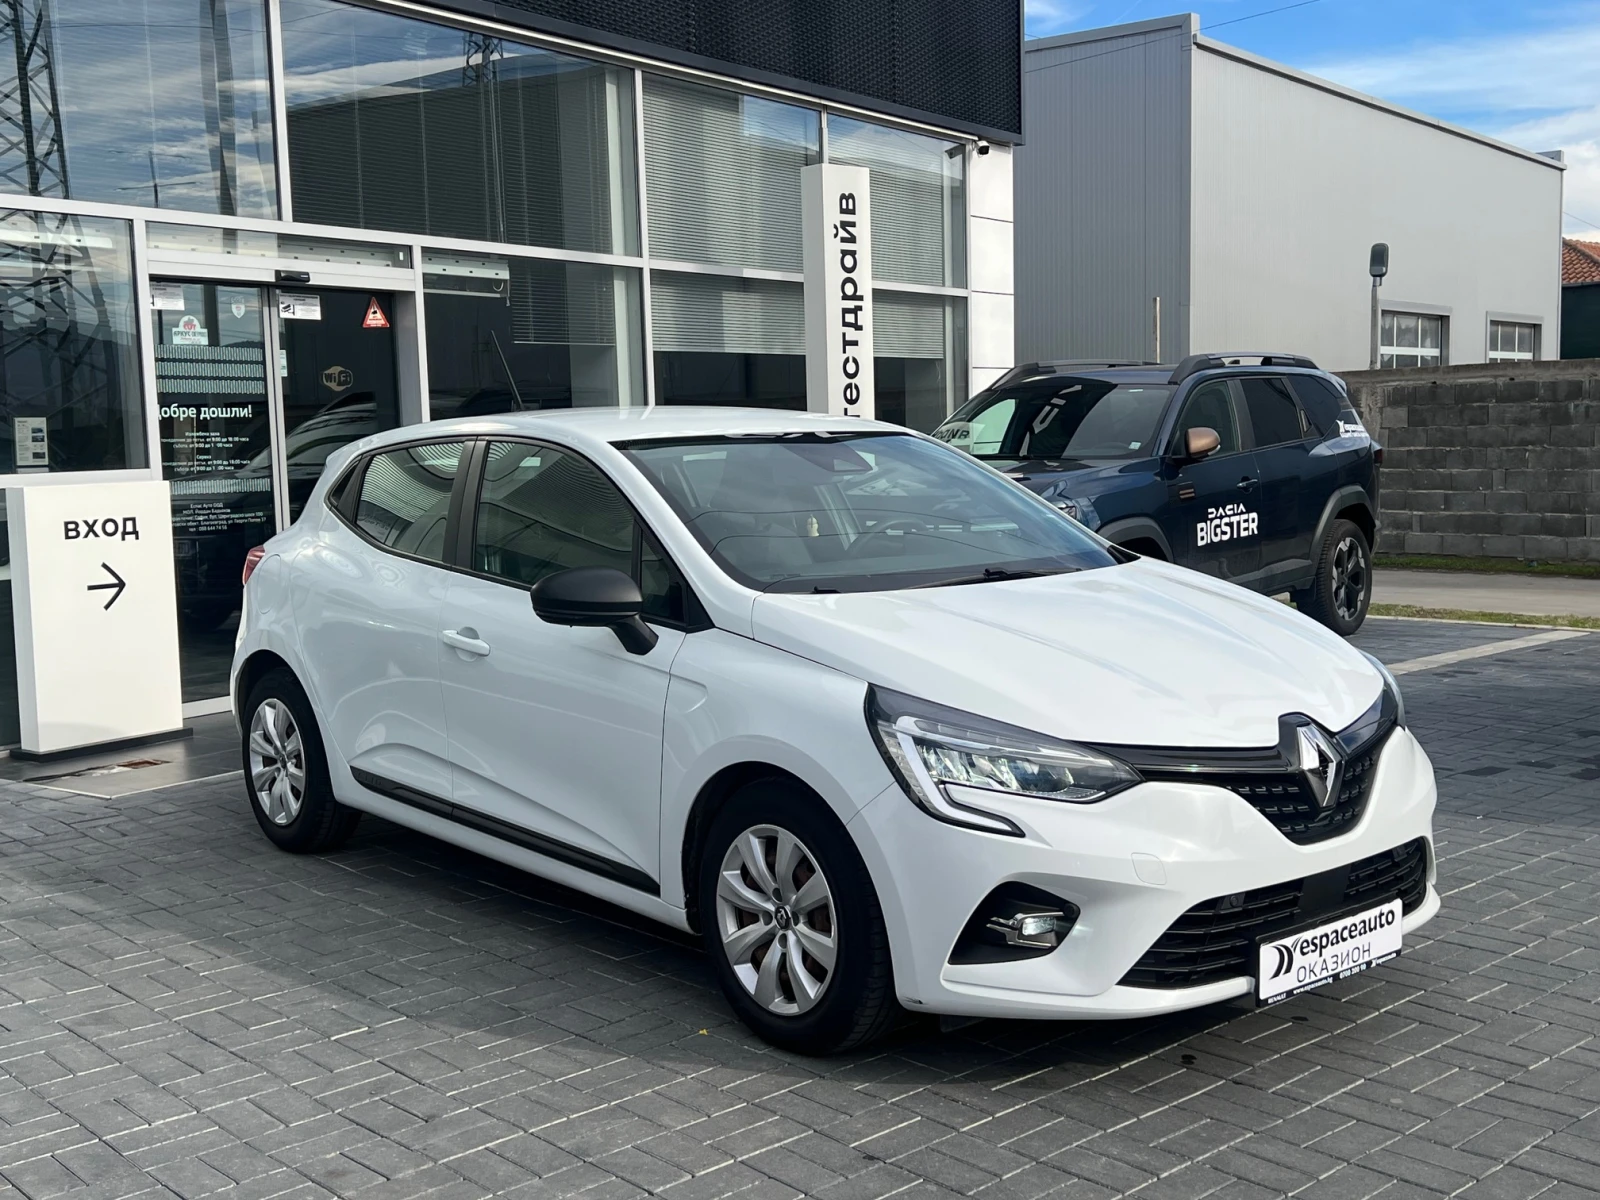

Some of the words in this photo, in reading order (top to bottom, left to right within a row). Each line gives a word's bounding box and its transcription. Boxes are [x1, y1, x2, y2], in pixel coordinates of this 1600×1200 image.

[159, 404, 196, 421] обре
[200, 404, 252, 420] дошли!
[1208, 502, 1246, 518] DACIA
[1196, 512, 1258, 546] BIGSTER
[1300, 909, 1396, 958] espaceauto
[1296, 942, 1372, 983] ОКАЗИОН
